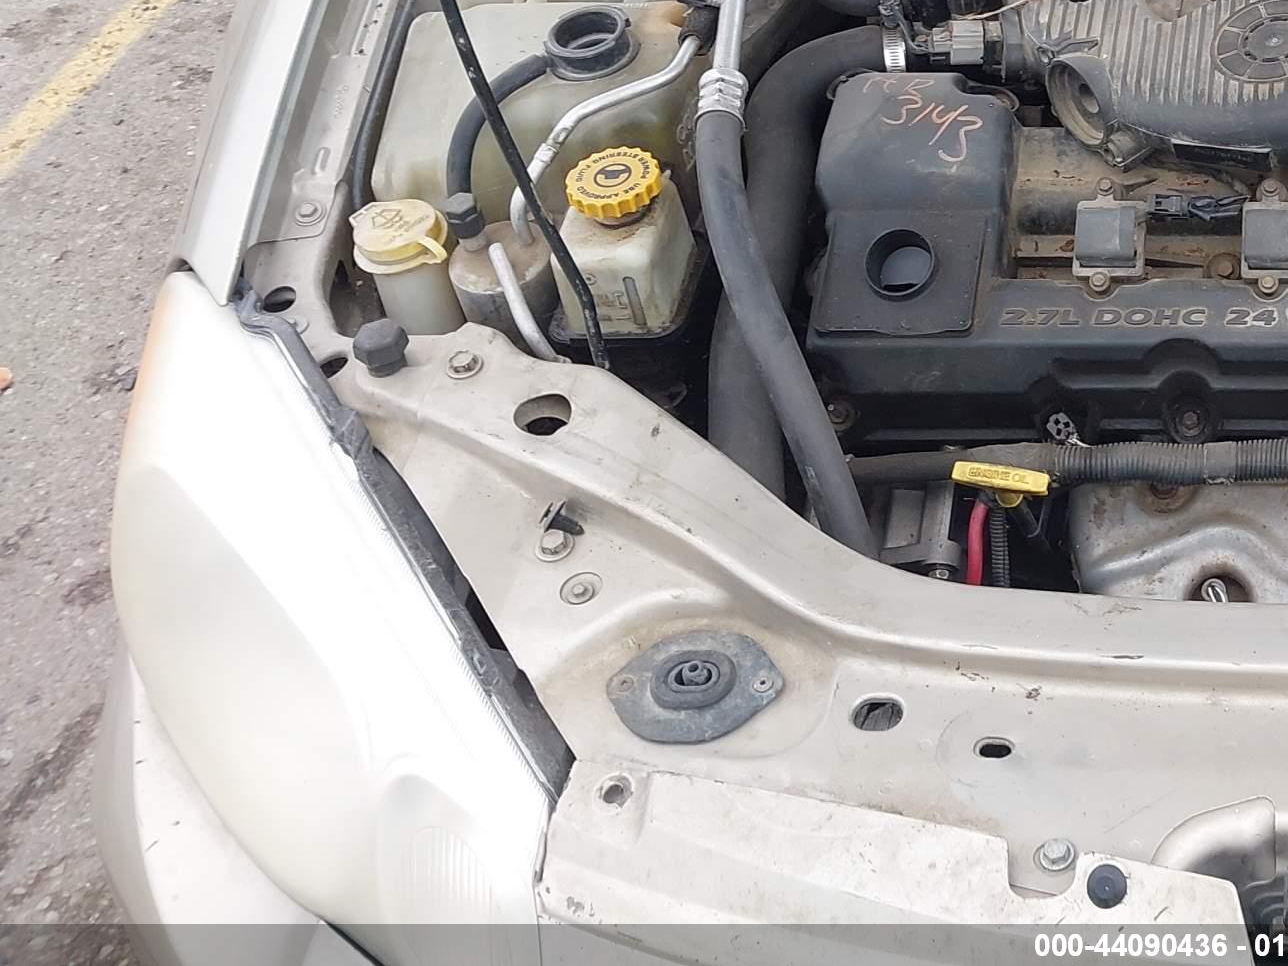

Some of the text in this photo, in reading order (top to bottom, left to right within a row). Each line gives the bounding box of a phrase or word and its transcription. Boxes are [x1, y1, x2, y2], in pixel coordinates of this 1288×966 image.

[880, 95, 983, 162] 3143
[575, 151, 652, 183] POWER STEERING FLUID
[576, 182, 641, 200] USE APPROVED
[1000, 307, 1081, 327] 2.7L
[1093, 307, 1208, 327] DOHC
[1224, 307, 1277, 327] 24
[968, 466, 1030, 485] ENGINE OIL
